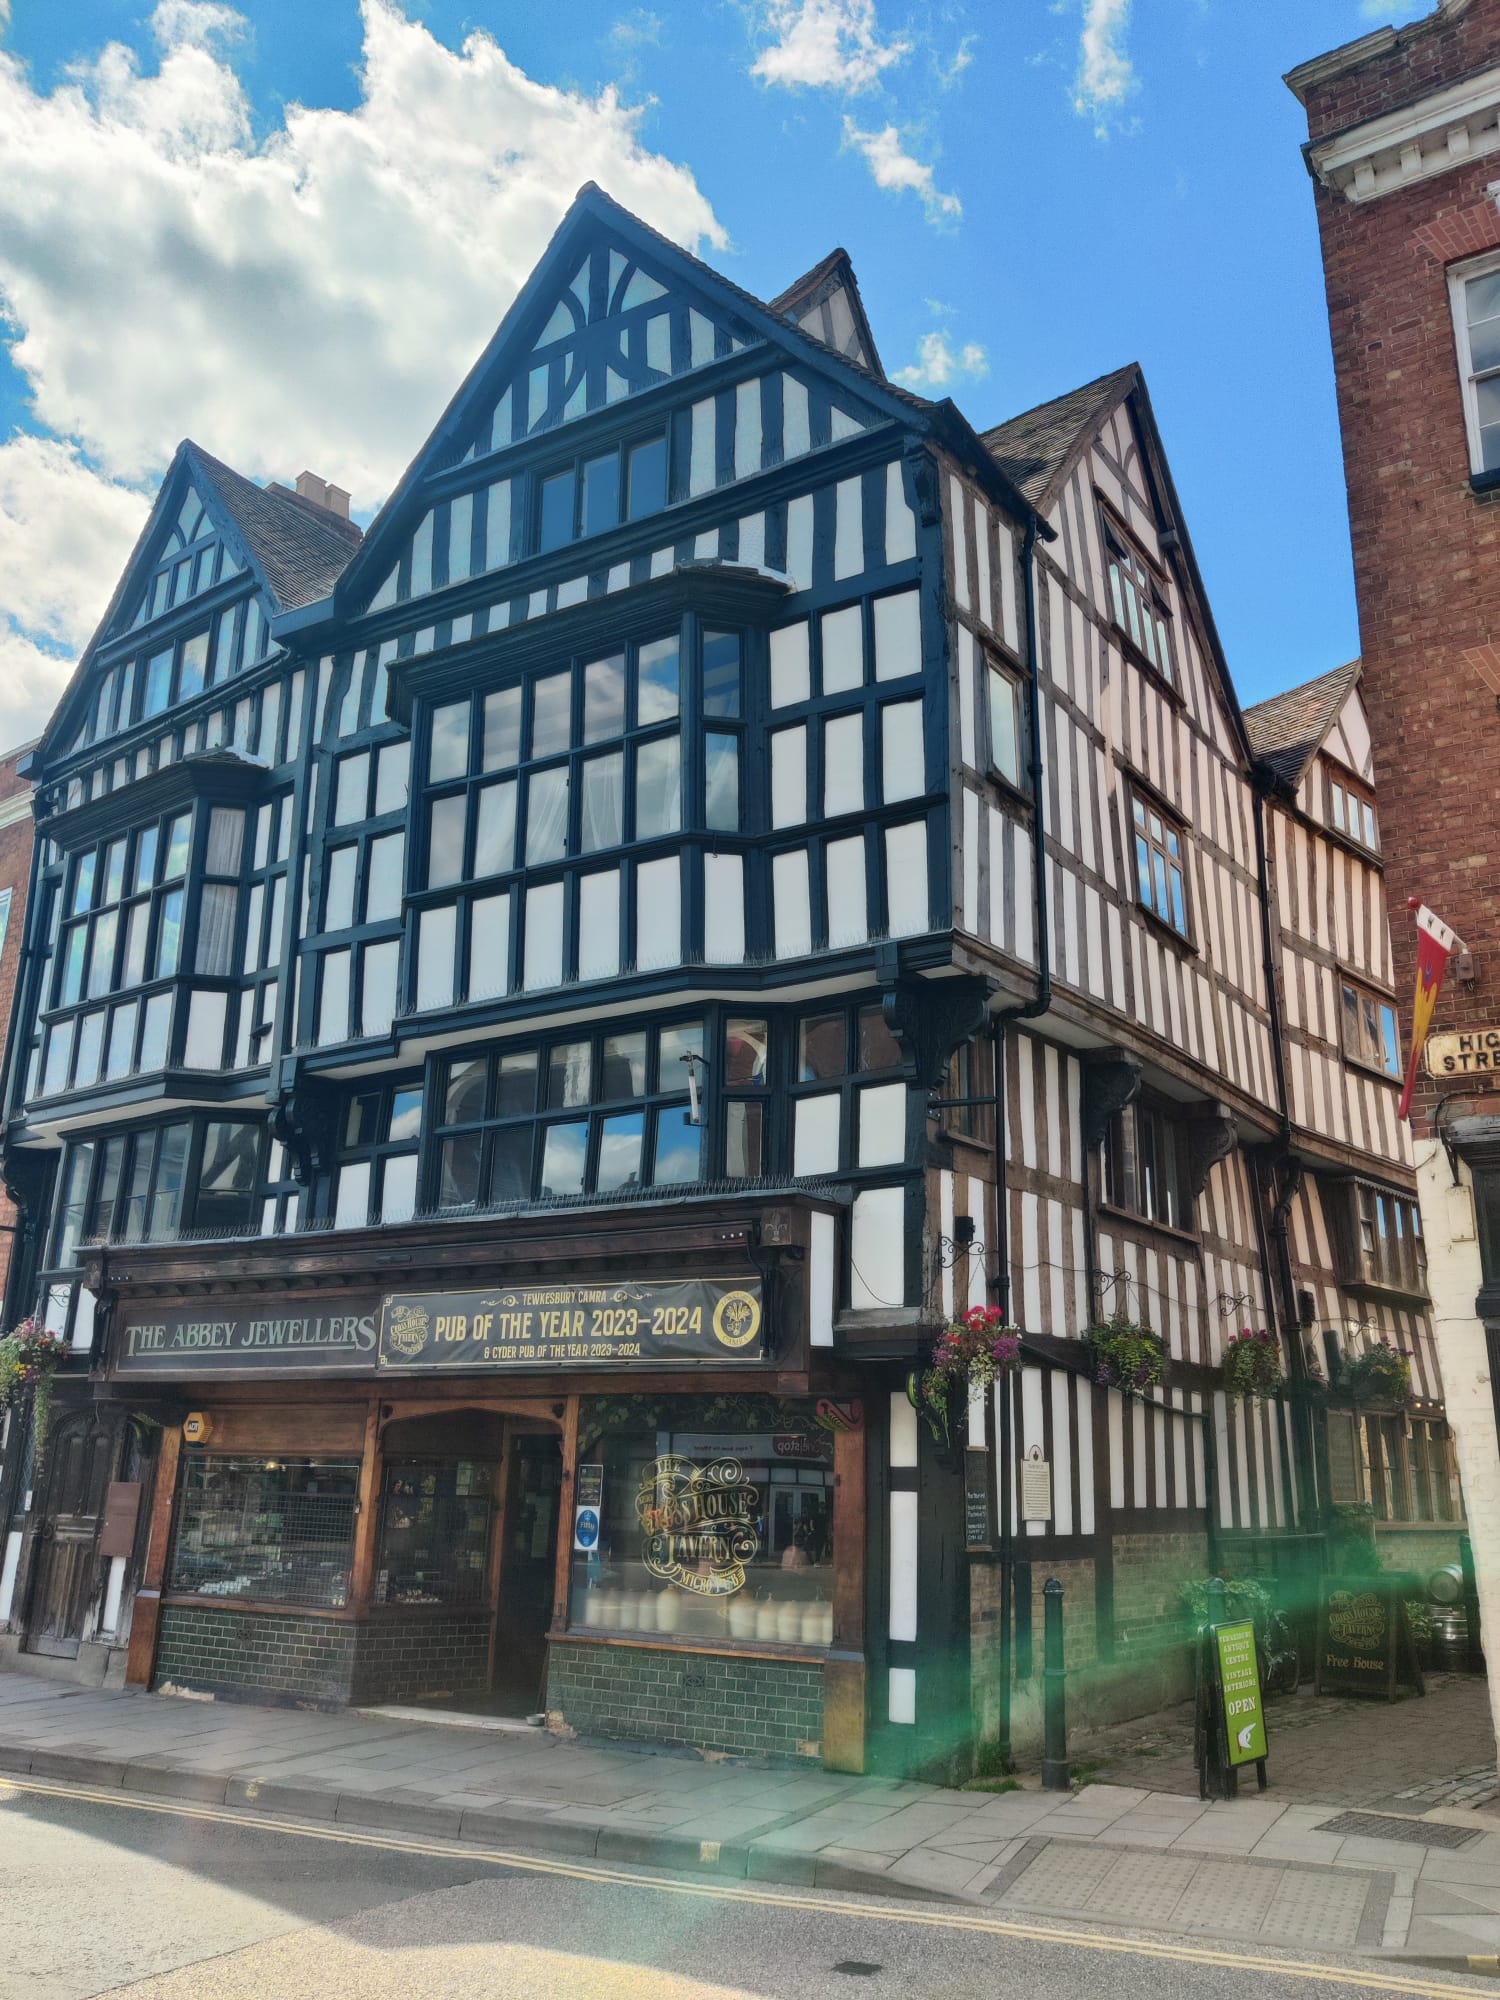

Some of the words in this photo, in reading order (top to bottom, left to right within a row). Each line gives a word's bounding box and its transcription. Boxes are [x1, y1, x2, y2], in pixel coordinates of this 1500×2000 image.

[522, 1292, 576, 1306] TEWKESBURY
[578, 1290, 607, 1303] CAMRA
[434, 1315, 467, 1342] PUB
[472, 1314, 494, 1341] OF
[500, 1312, 533, 1340] THE
[539, 1309, 585, 1338] YEAR
[125, 1325, 166, 1357] THE
[170, 1321, 237, 1348] ABBEY
[241, 1316, 377, 1351] JEWELLERS
[484, 1347, 490, 1359] &
[492, 1346, 517, 1359] CYDER
[519, 1345, 535, 1358] PUB
[537, 1345, 548, 1358] OF
[550, 1344, 565, 1358] THE
[567, 1343, 588, 1357] YEAR
[188, 1422, 200, 1432] ADT
[656, 1459, 681, 1473] THE
[692, 1490, 750, 1522] HOUSE
[660, 1534, 731, 1568] TAVERN
[1223, 1641, 1250, 1653] ANTIQUE
[1226, 1653, 1249, 1665] CENTRE
[1326, 1653, 1349, 1668] Free
[1226, 1667, 1253, 1681] VINTAGE
[1223, 1679, 1256, 1693] INTERIORS
[1229, 1695, 1256, 1716] OPEN
